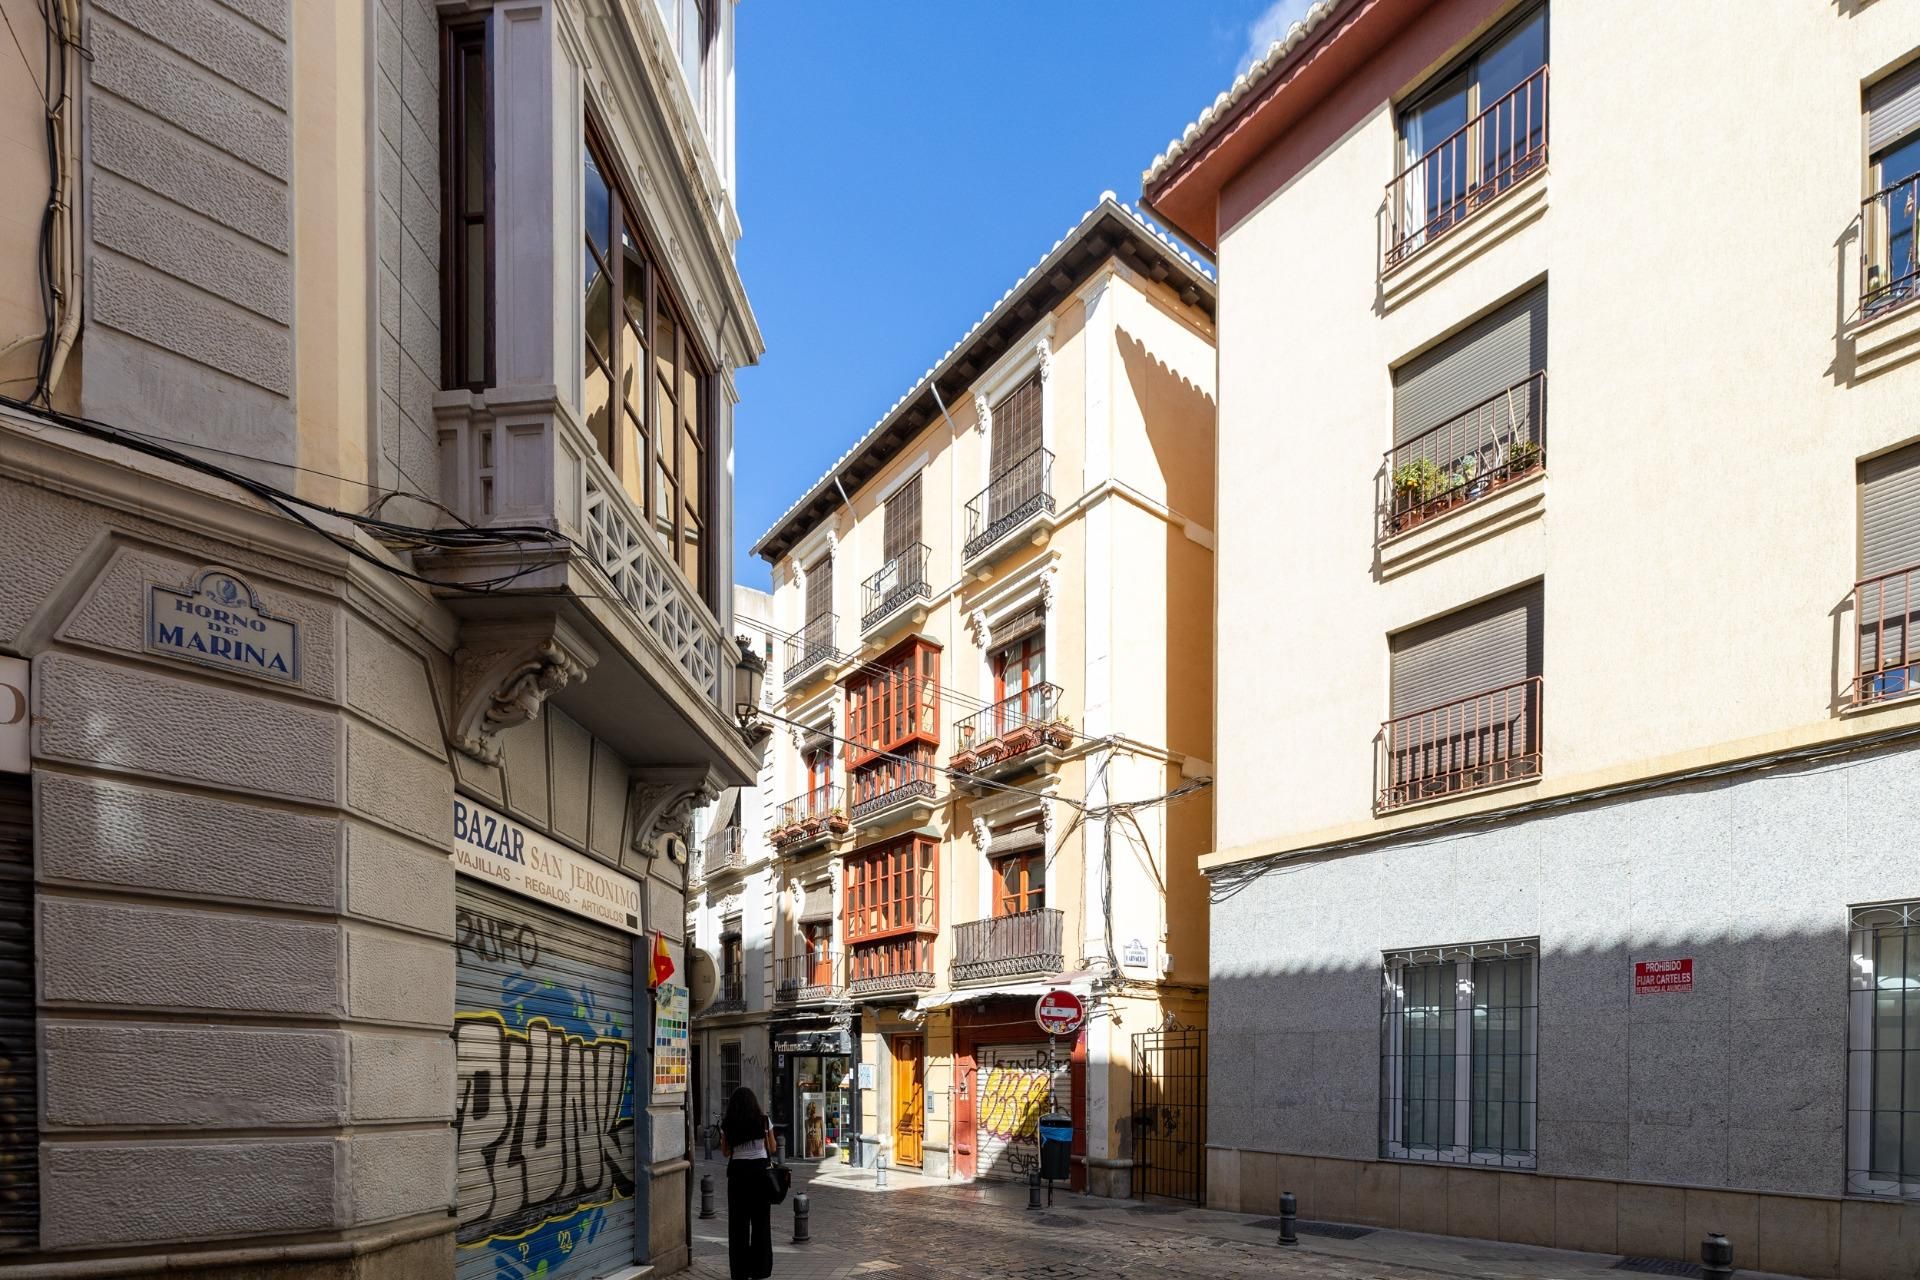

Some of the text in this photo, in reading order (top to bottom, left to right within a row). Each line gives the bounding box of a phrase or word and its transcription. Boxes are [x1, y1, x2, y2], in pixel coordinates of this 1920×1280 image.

[175, 599, 266, 632] HORNO
[208, 621, 238, 636] DE
[159, 622, 289, 673] MARINA
[454, 800, 639, 912] BAZAR SAN JERONIMO
[456, 848, 511, 882] VAJILLAS
[525, 876, 571, 904] REGALOS
[581, 902, 624, 924] ARTICULOS
[1636, 972, 1691, 986] FIJAR CARTELES
[1645, 961, 1682, 972] PROHIBIDO
